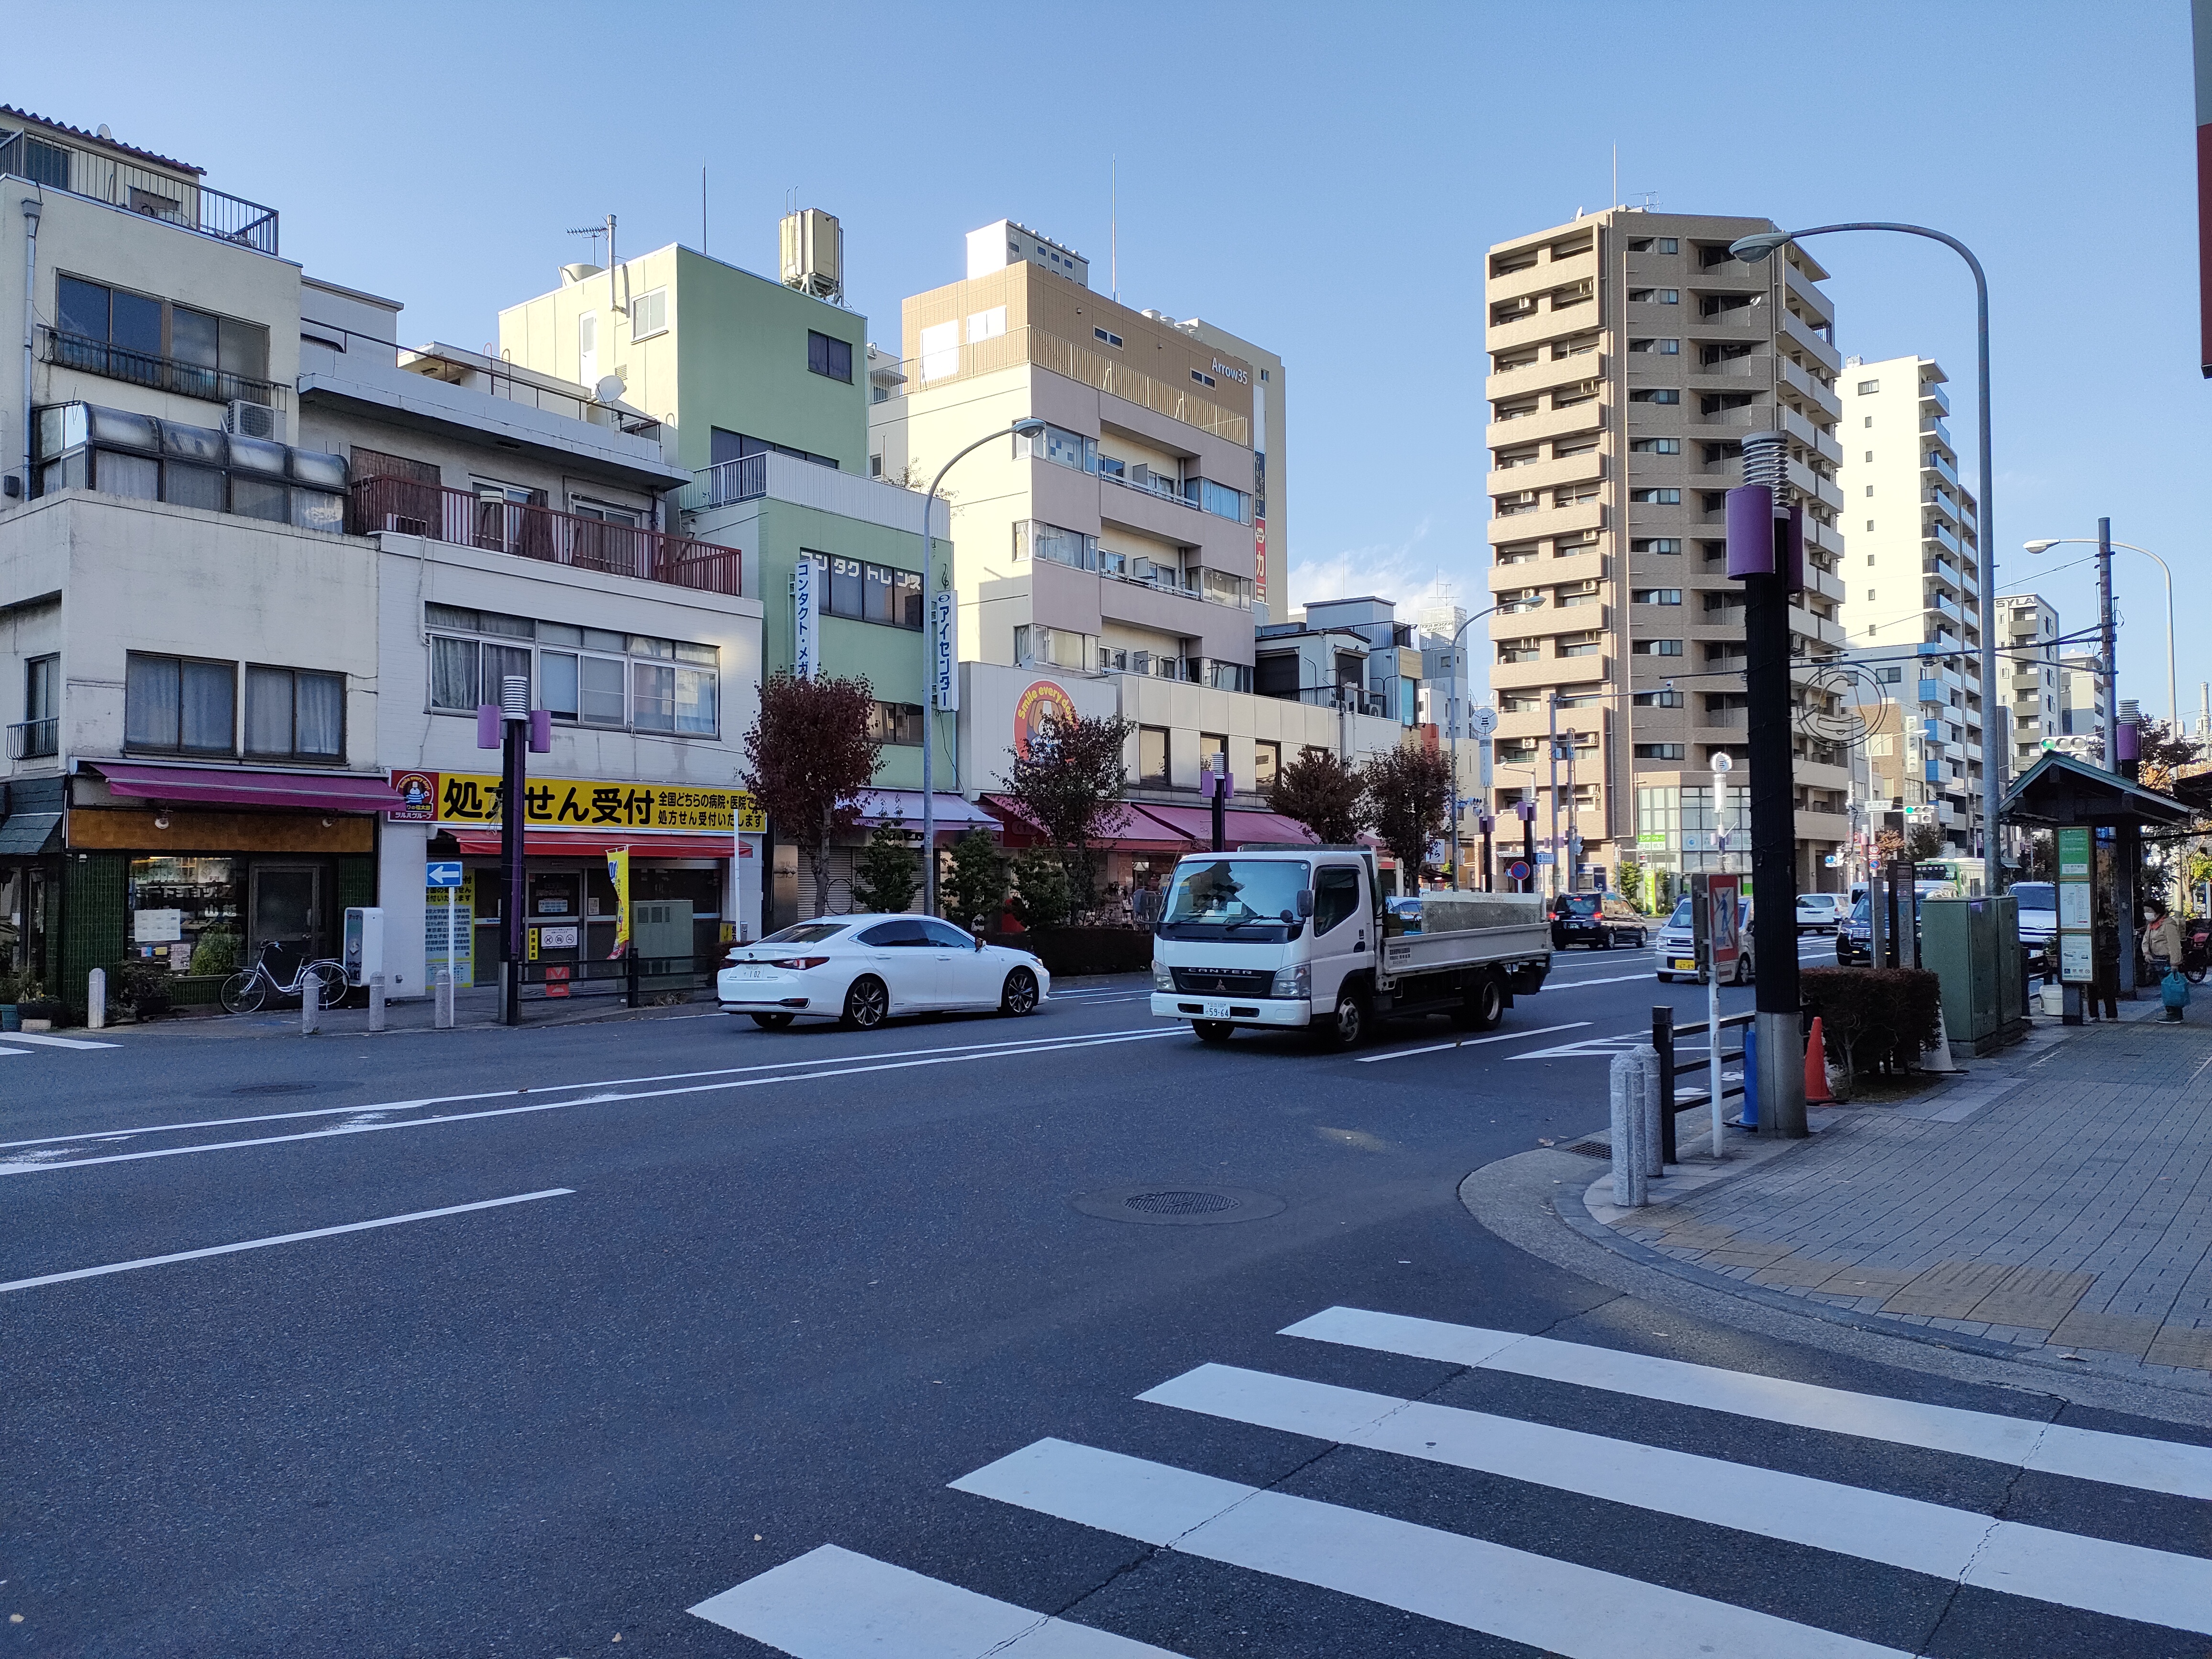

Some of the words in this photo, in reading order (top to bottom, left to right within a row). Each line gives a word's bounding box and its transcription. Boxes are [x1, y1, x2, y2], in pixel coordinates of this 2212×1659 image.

[1212, 357, 1248, 385] Arrow35
[1995, 597, 2034, 608] SYLA
[939, 605, 950, 707] アイセンター
[1018, 689, 1038, 719] Smile
[1038, 686, 1062, 703] every
[658, 809, 762, 828] 処方せん受付いたします
[1209, 1008, 1229, 1017] 59-64
